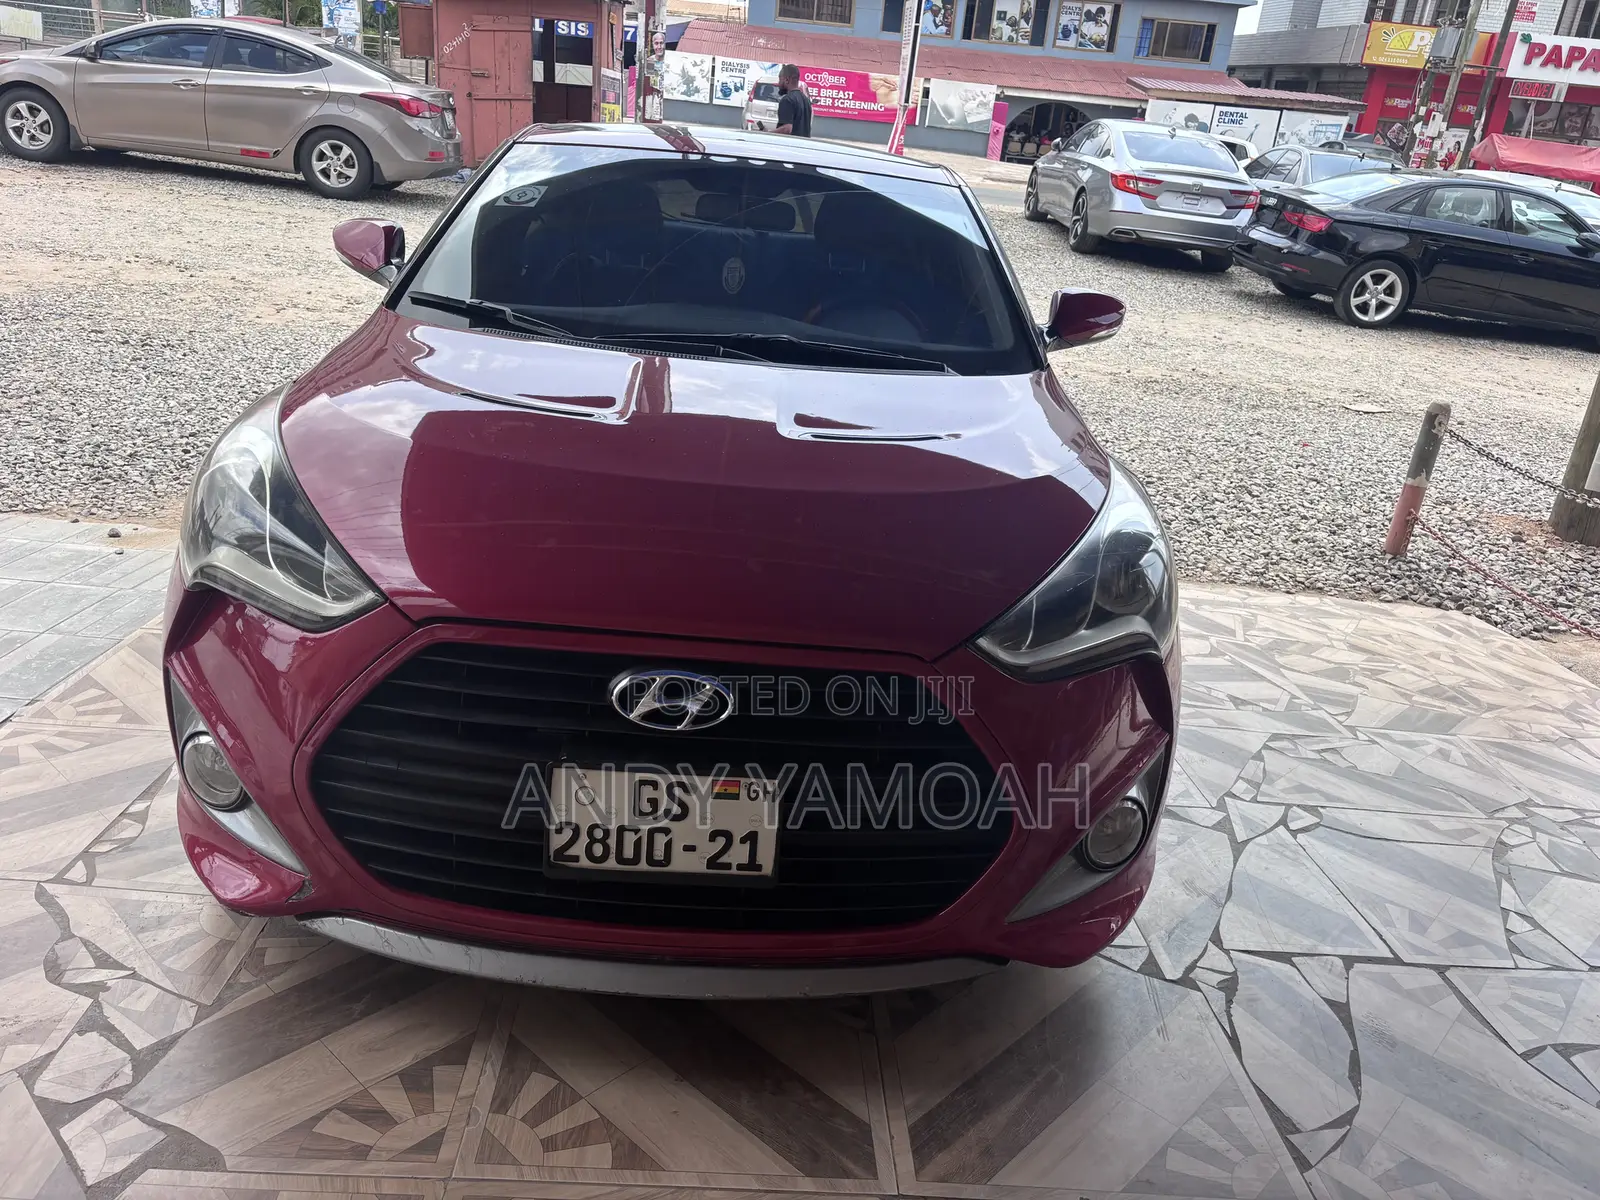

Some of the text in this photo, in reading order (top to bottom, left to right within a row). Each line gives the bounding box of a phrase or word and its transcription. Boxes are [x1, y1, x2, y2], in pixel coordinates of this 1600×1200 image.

[625, 27, 635, 40] 7
[1524, 42, 1600, 72] PAPA
[722, 60, 750, 69] DIALYSIS
[820, 88, 854, 100] BREAST
[834, 99, 884, 112] SCREENING
[1218, 110, 1249, 119] DENTAL
[1218, 118, 1244, 126] CLINIC
[746, 781, 779, 803] GH
[633, 779, 691, 822] GS
